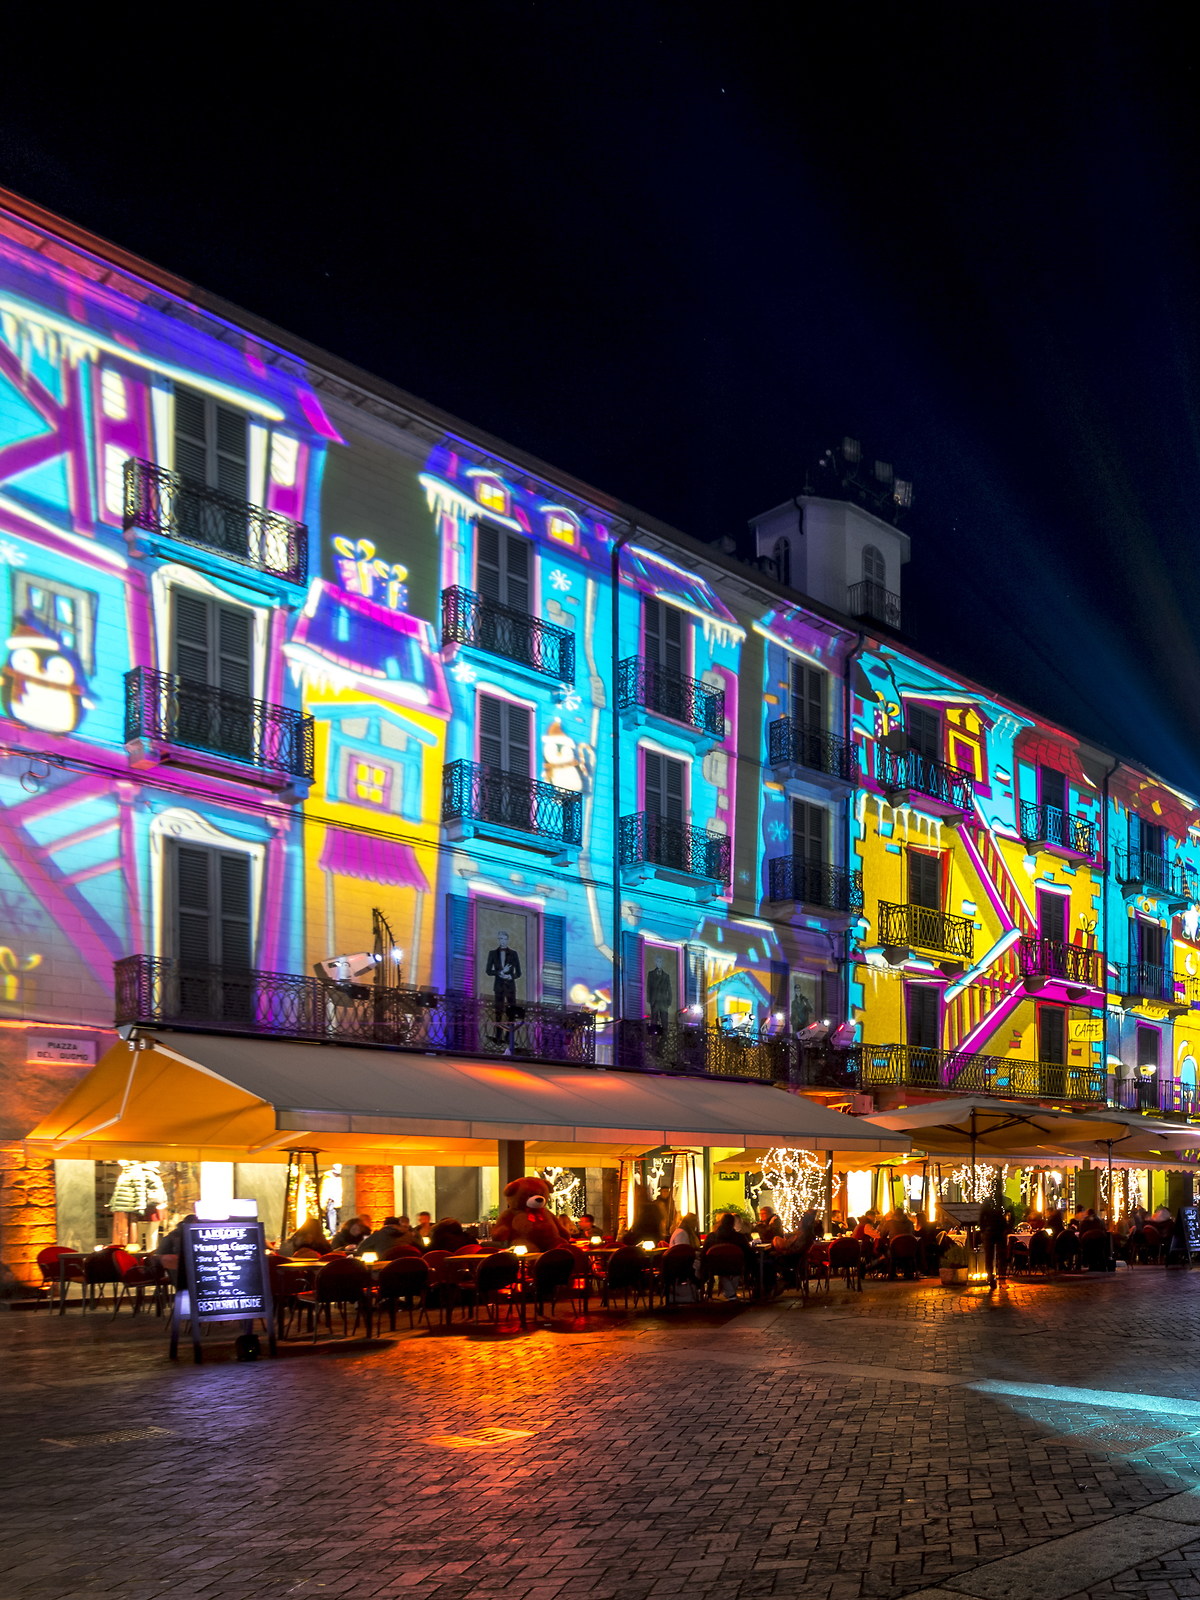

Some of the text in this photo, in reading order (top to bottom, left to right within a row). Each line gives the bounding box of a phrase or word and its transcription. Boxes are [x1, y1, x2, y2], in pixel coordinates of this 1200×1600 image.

[47, 1042, 78, 1050] PIAZZA
[37, 1051, 89, 1061] DEL DUOMO
